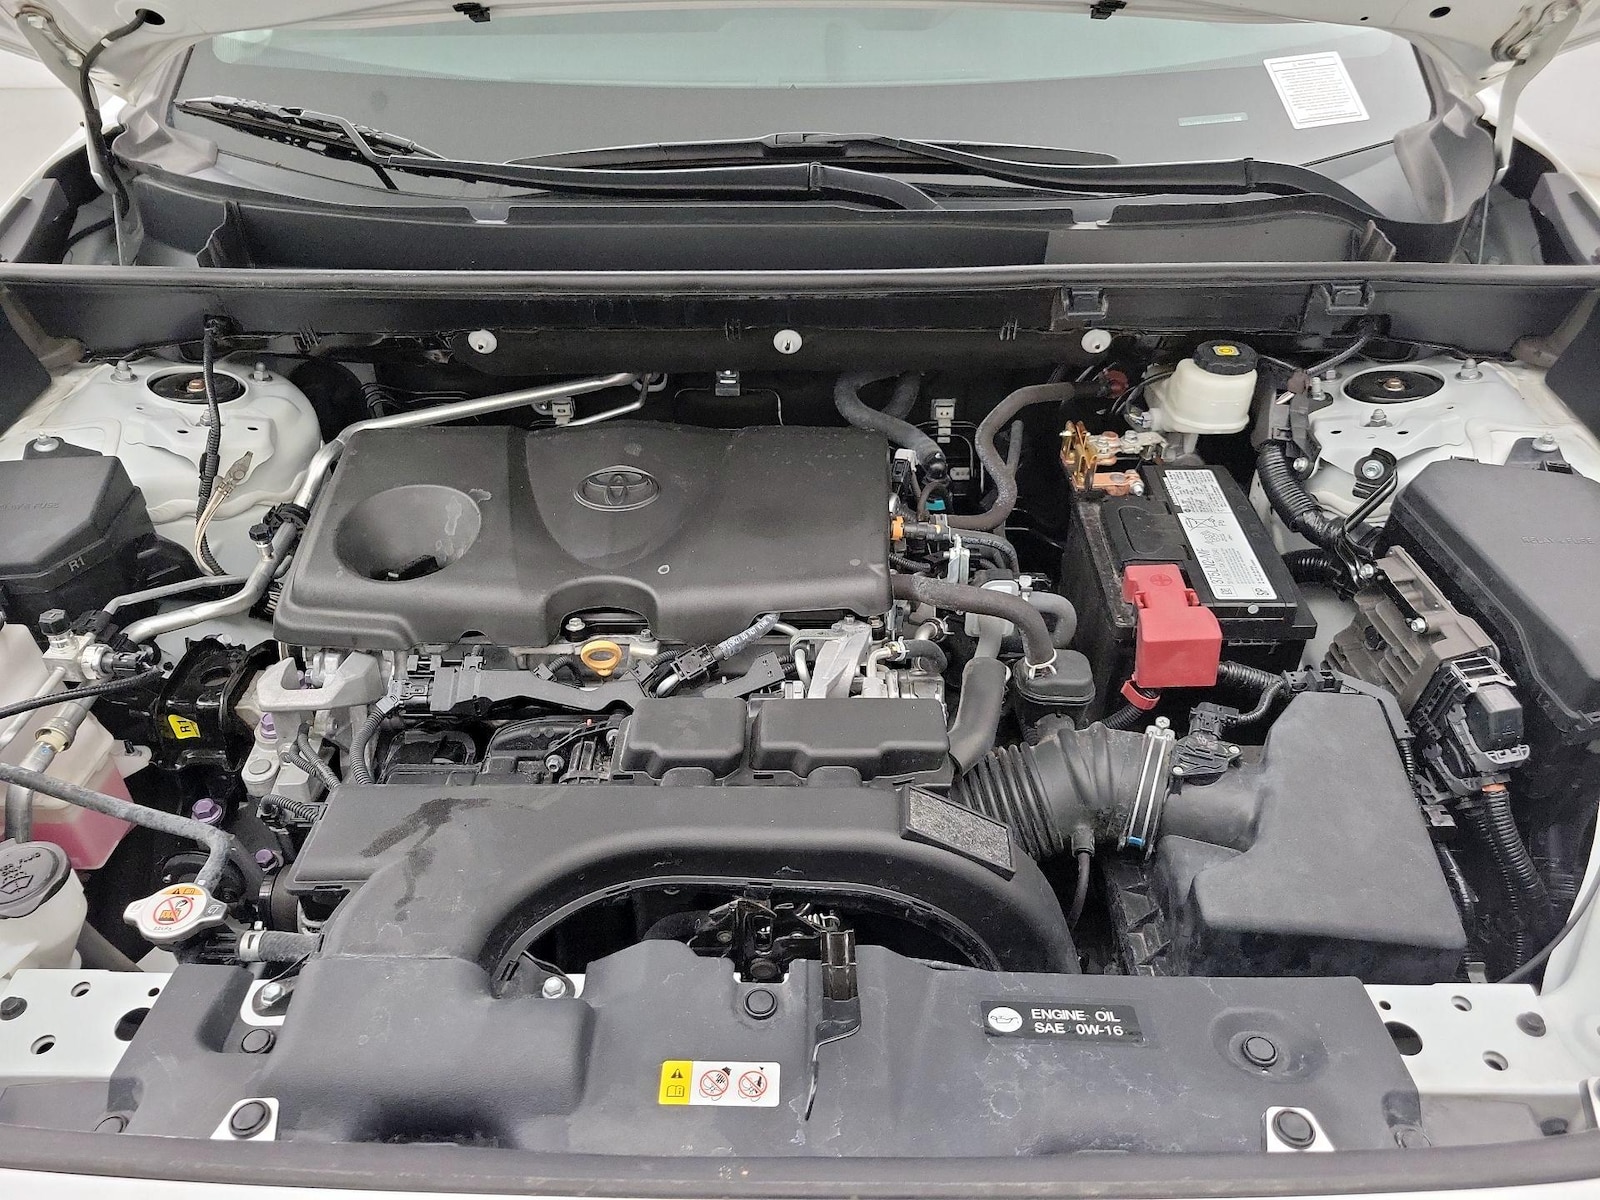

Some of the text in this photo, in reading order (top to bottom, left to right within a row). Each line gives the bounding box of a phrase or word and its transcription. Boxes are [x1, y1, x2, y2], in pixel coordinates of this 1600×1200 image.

[68, 556, 85, 572] R1
[176, 720, 191, 733] R1
[1031, 1008, 1121, 1022] ENGINE OIL
[1034, 1022, 1124, 1036] SAE 0W-16
